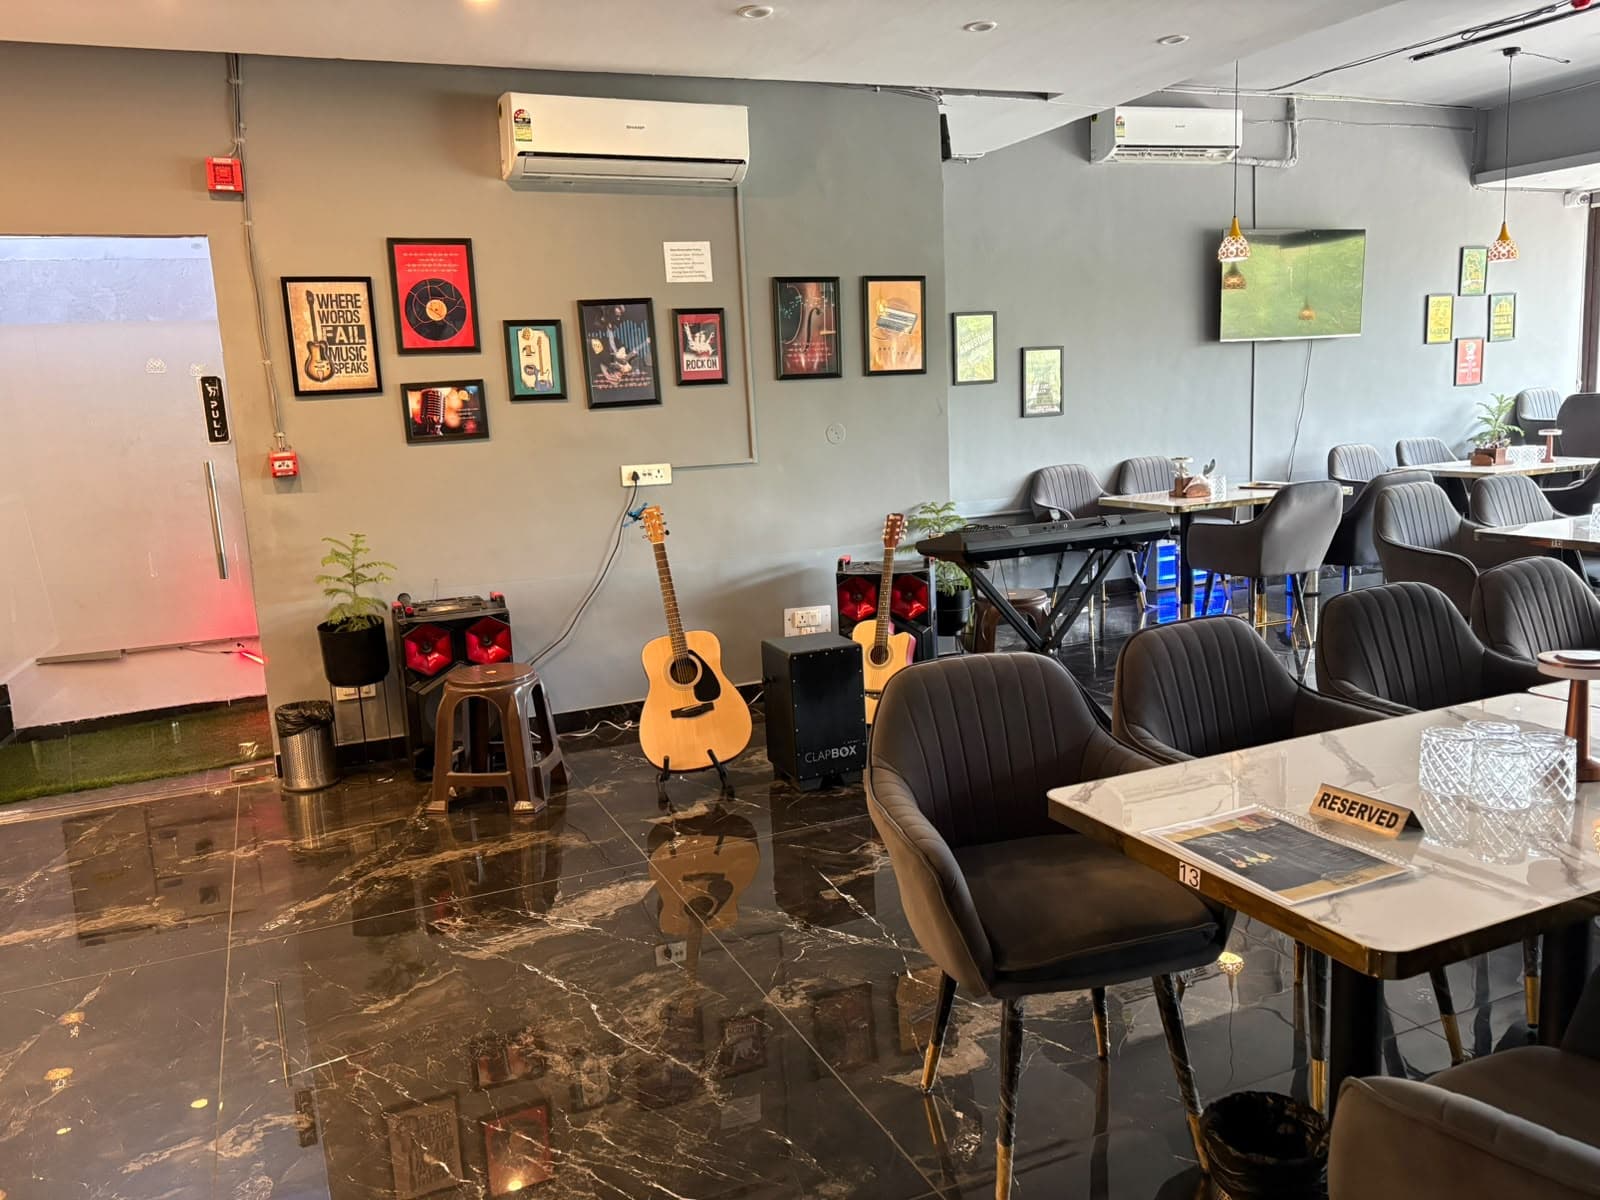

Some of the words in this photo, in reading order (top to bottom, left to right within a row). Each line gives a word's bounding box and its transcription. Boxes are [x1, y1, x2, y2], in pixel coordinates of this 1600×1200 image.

[316, 293, 362, 309] WHERE
[317, 310, 361, 324] WORDS
[322, 326, 366, 344] FAIL
[328, 346, 367, 362] MUSIC
[334, 362, 369, 375] SPEAKS
[685, 359, 706, 370] ROCK
[706, 358, 718, 369] ON
[209, 400, 227, 438] PULL
[804, 744, 857, 763] CLAPBOX
[1317, 791, 1400, 829] RESERVED
[1180, 863, 1200, 888] 13
